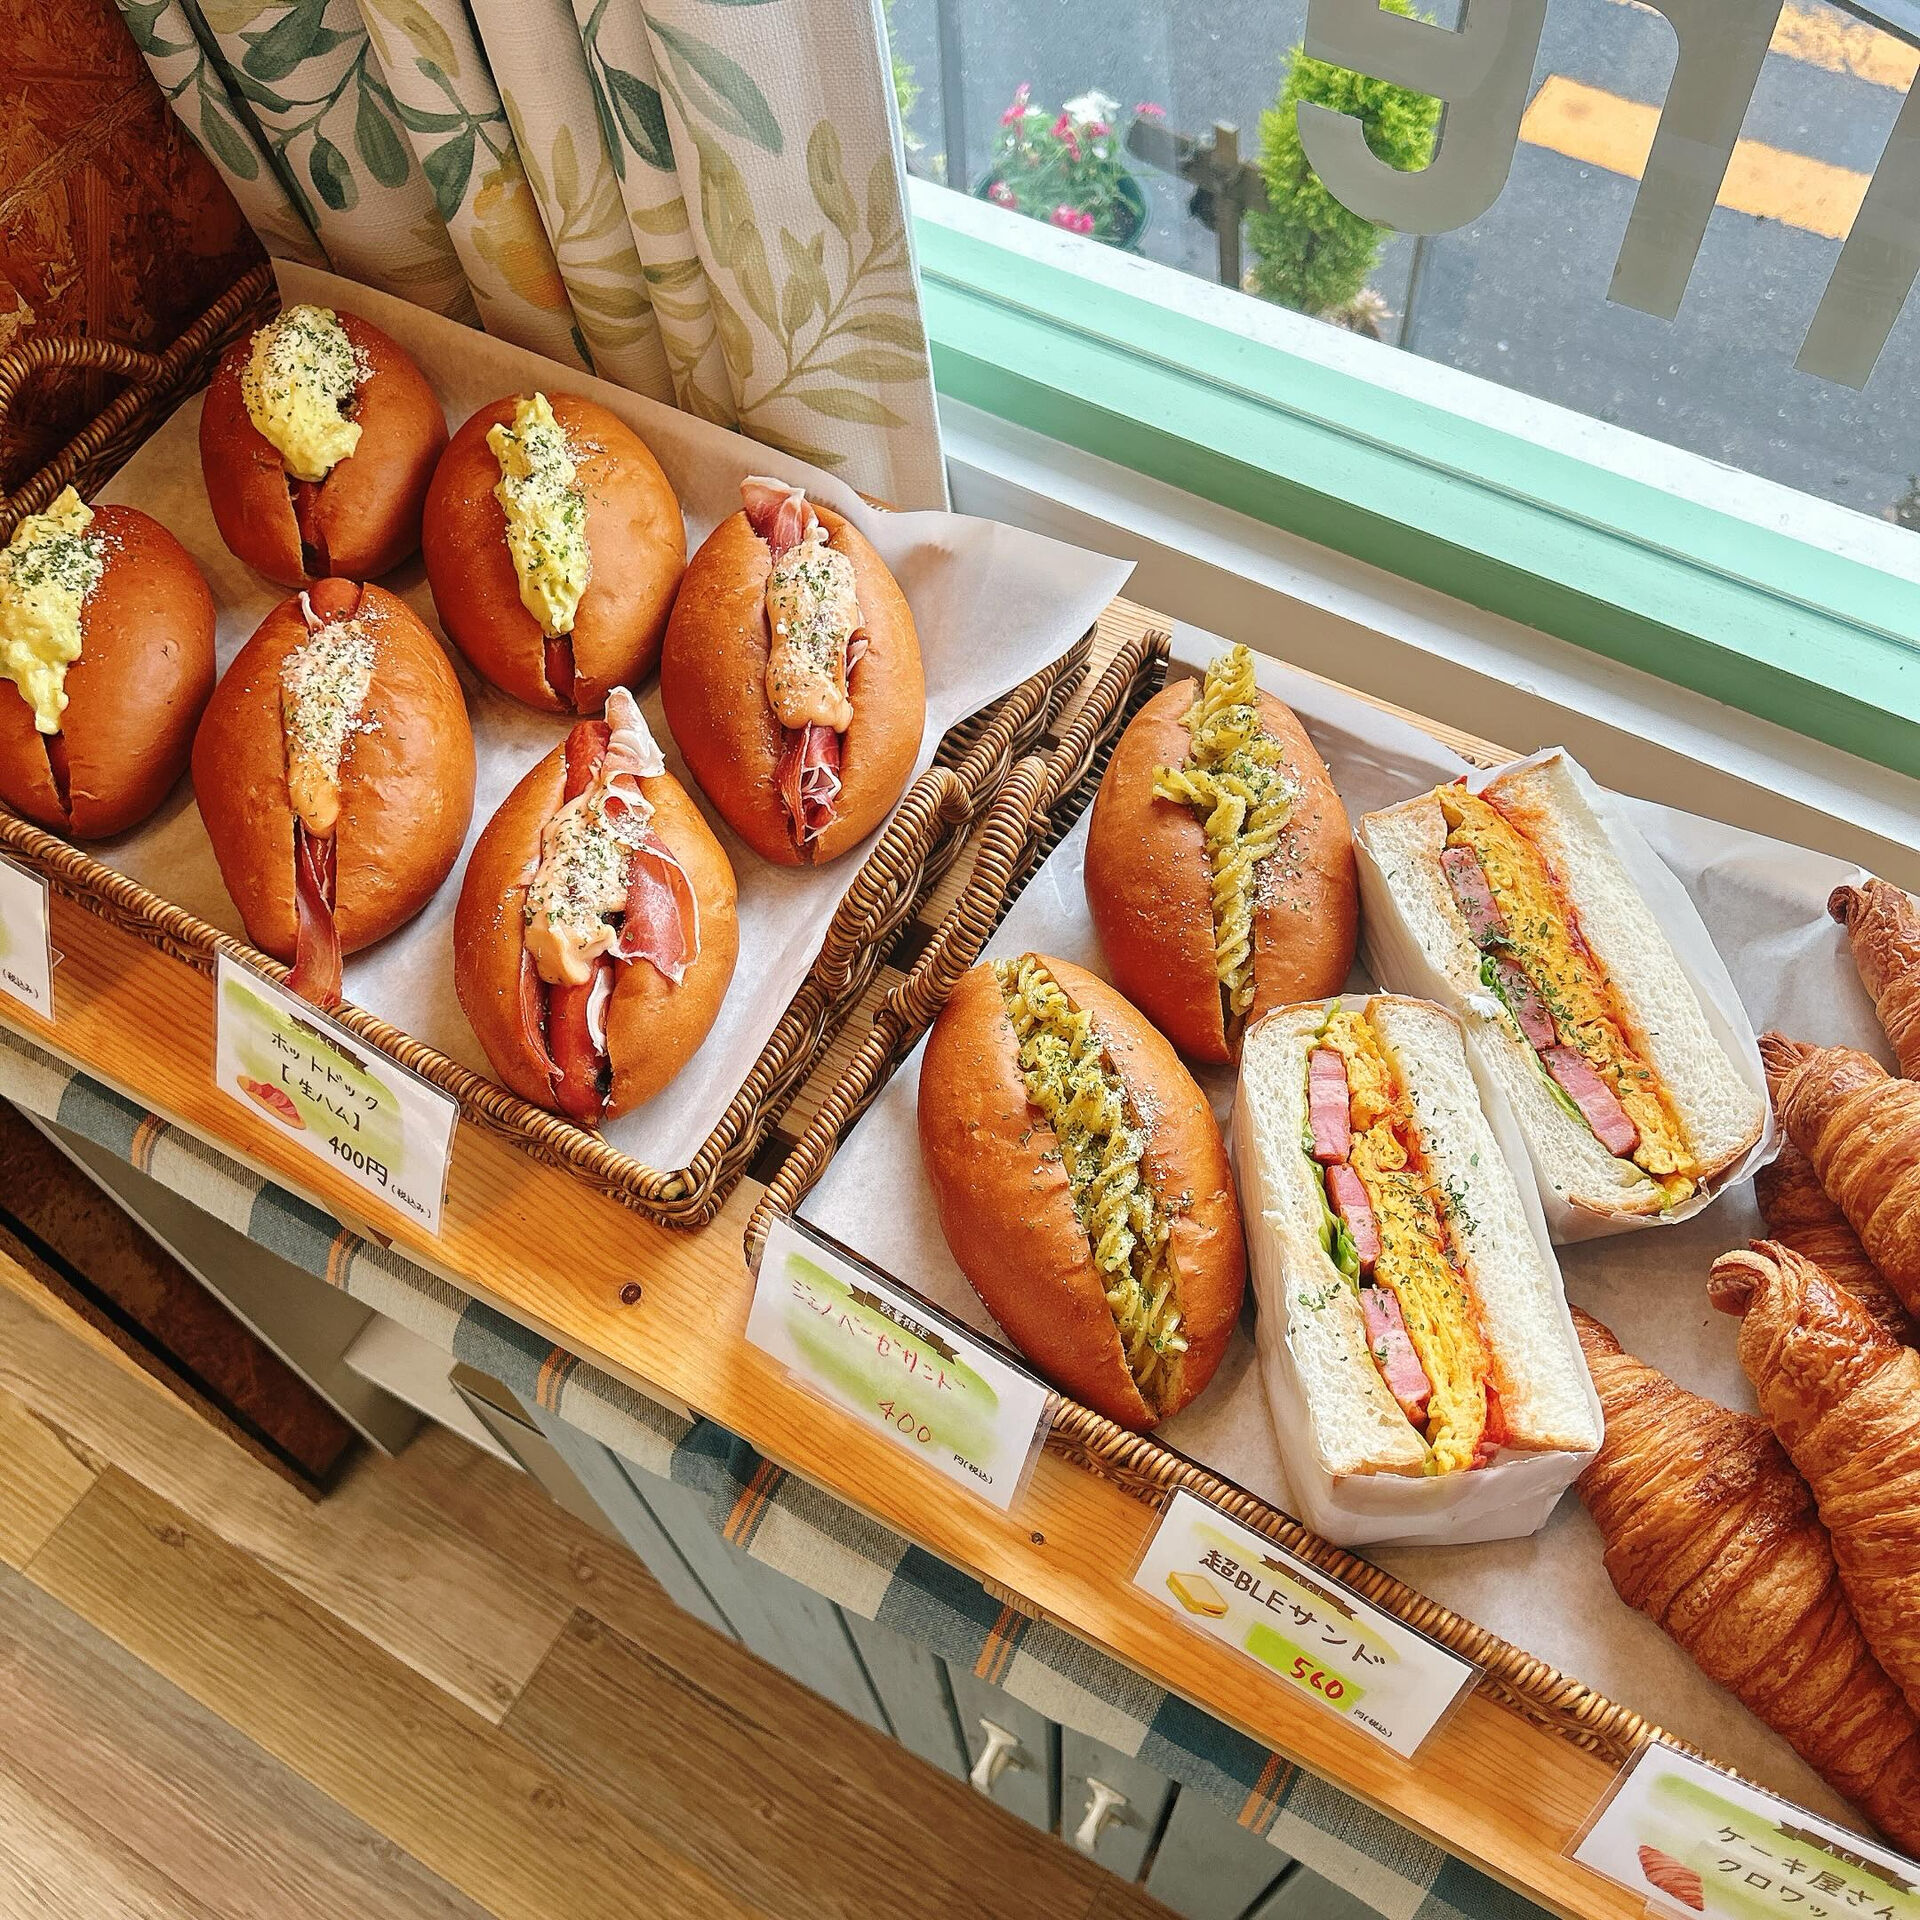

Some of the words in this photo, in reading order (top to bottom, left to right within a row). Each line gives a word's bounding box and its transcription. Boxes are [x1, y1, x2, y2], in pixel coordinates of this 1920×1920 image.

[271, 1031, 379, 1111] ホットドック
[328, 1135, 388, 1187] 400円
[876, 1400, 932, 1443] 400
[1198, 1549, 1386, 1666] 超BLEサンド
[1290, 1656, 1345, 1700] 560
